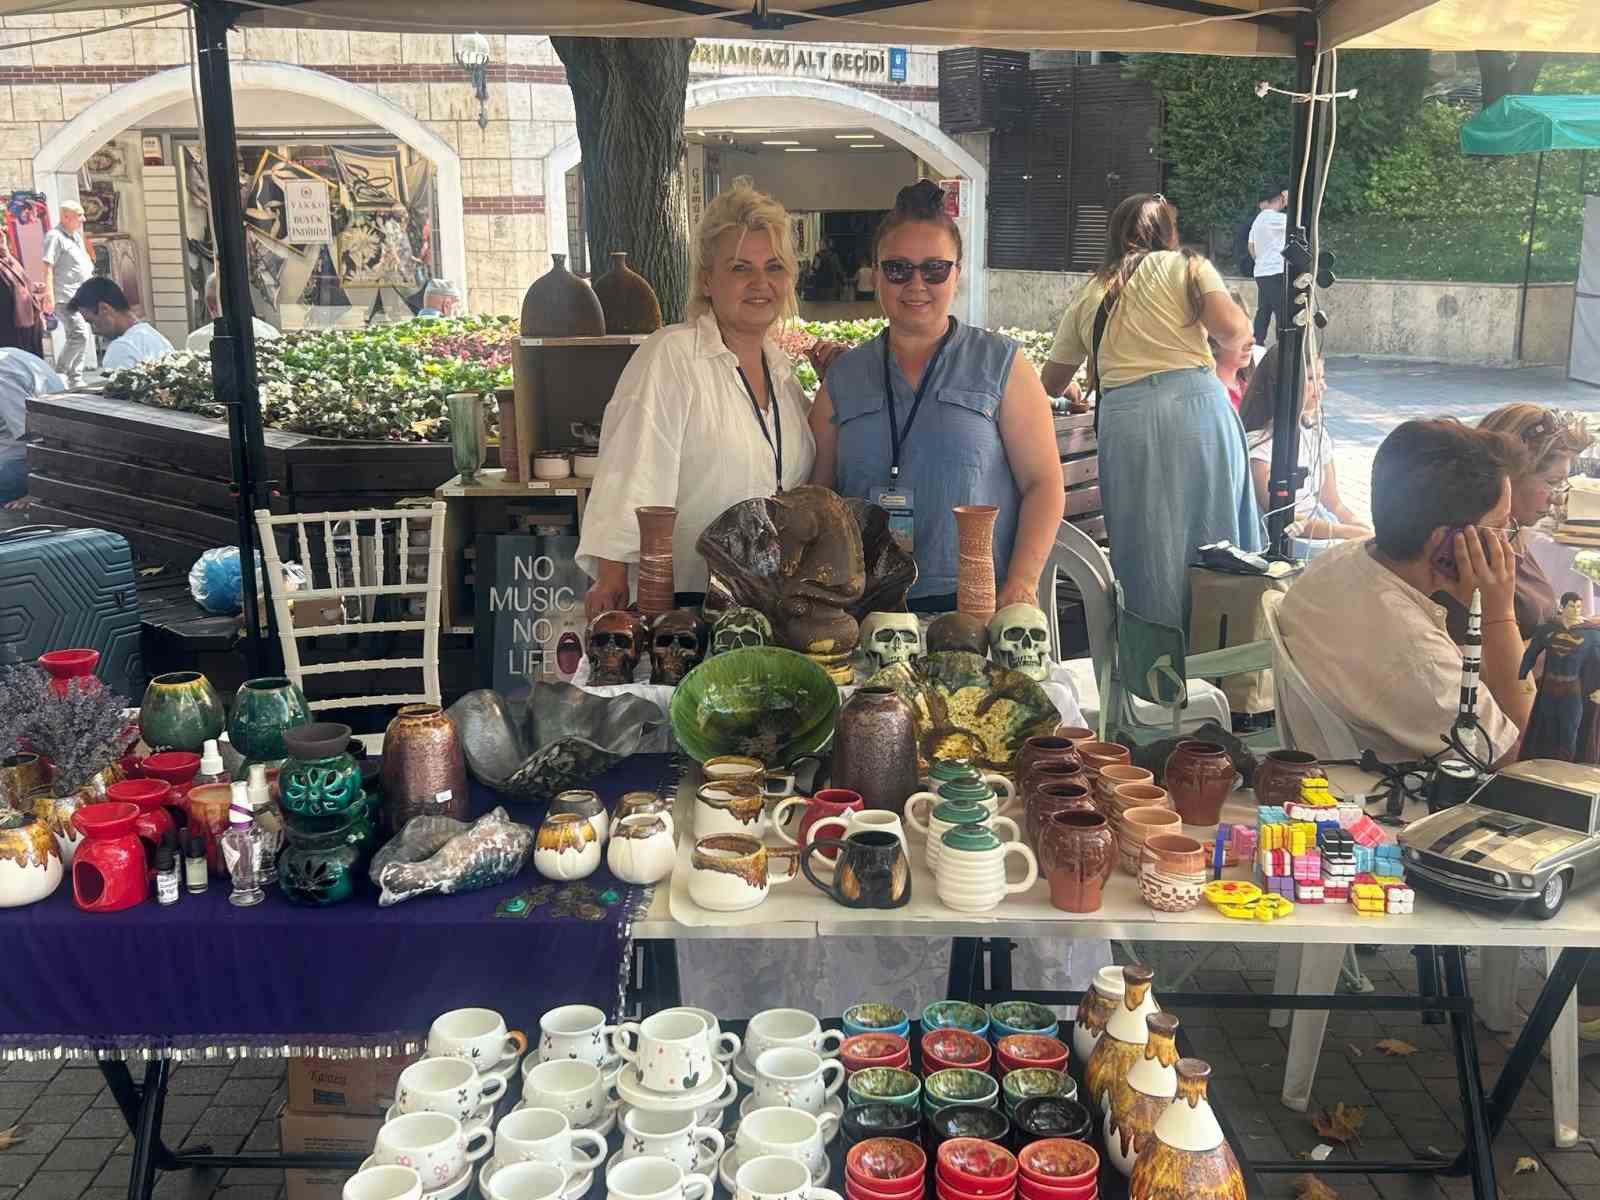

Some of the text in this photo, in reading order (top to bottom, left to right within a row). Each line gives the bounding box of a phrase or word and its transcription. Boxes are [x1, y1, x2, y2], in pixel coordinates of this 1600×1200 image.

[793, 52, 827, 69] ALT
[832, 50, 885, 75] GEÇİDİ
[514, 555, 554, 581] NO
[489, 586, 575, 612] MUSIC
[513, 618, 553, 643] NO
[508, 649, 556, 675] LIFE
